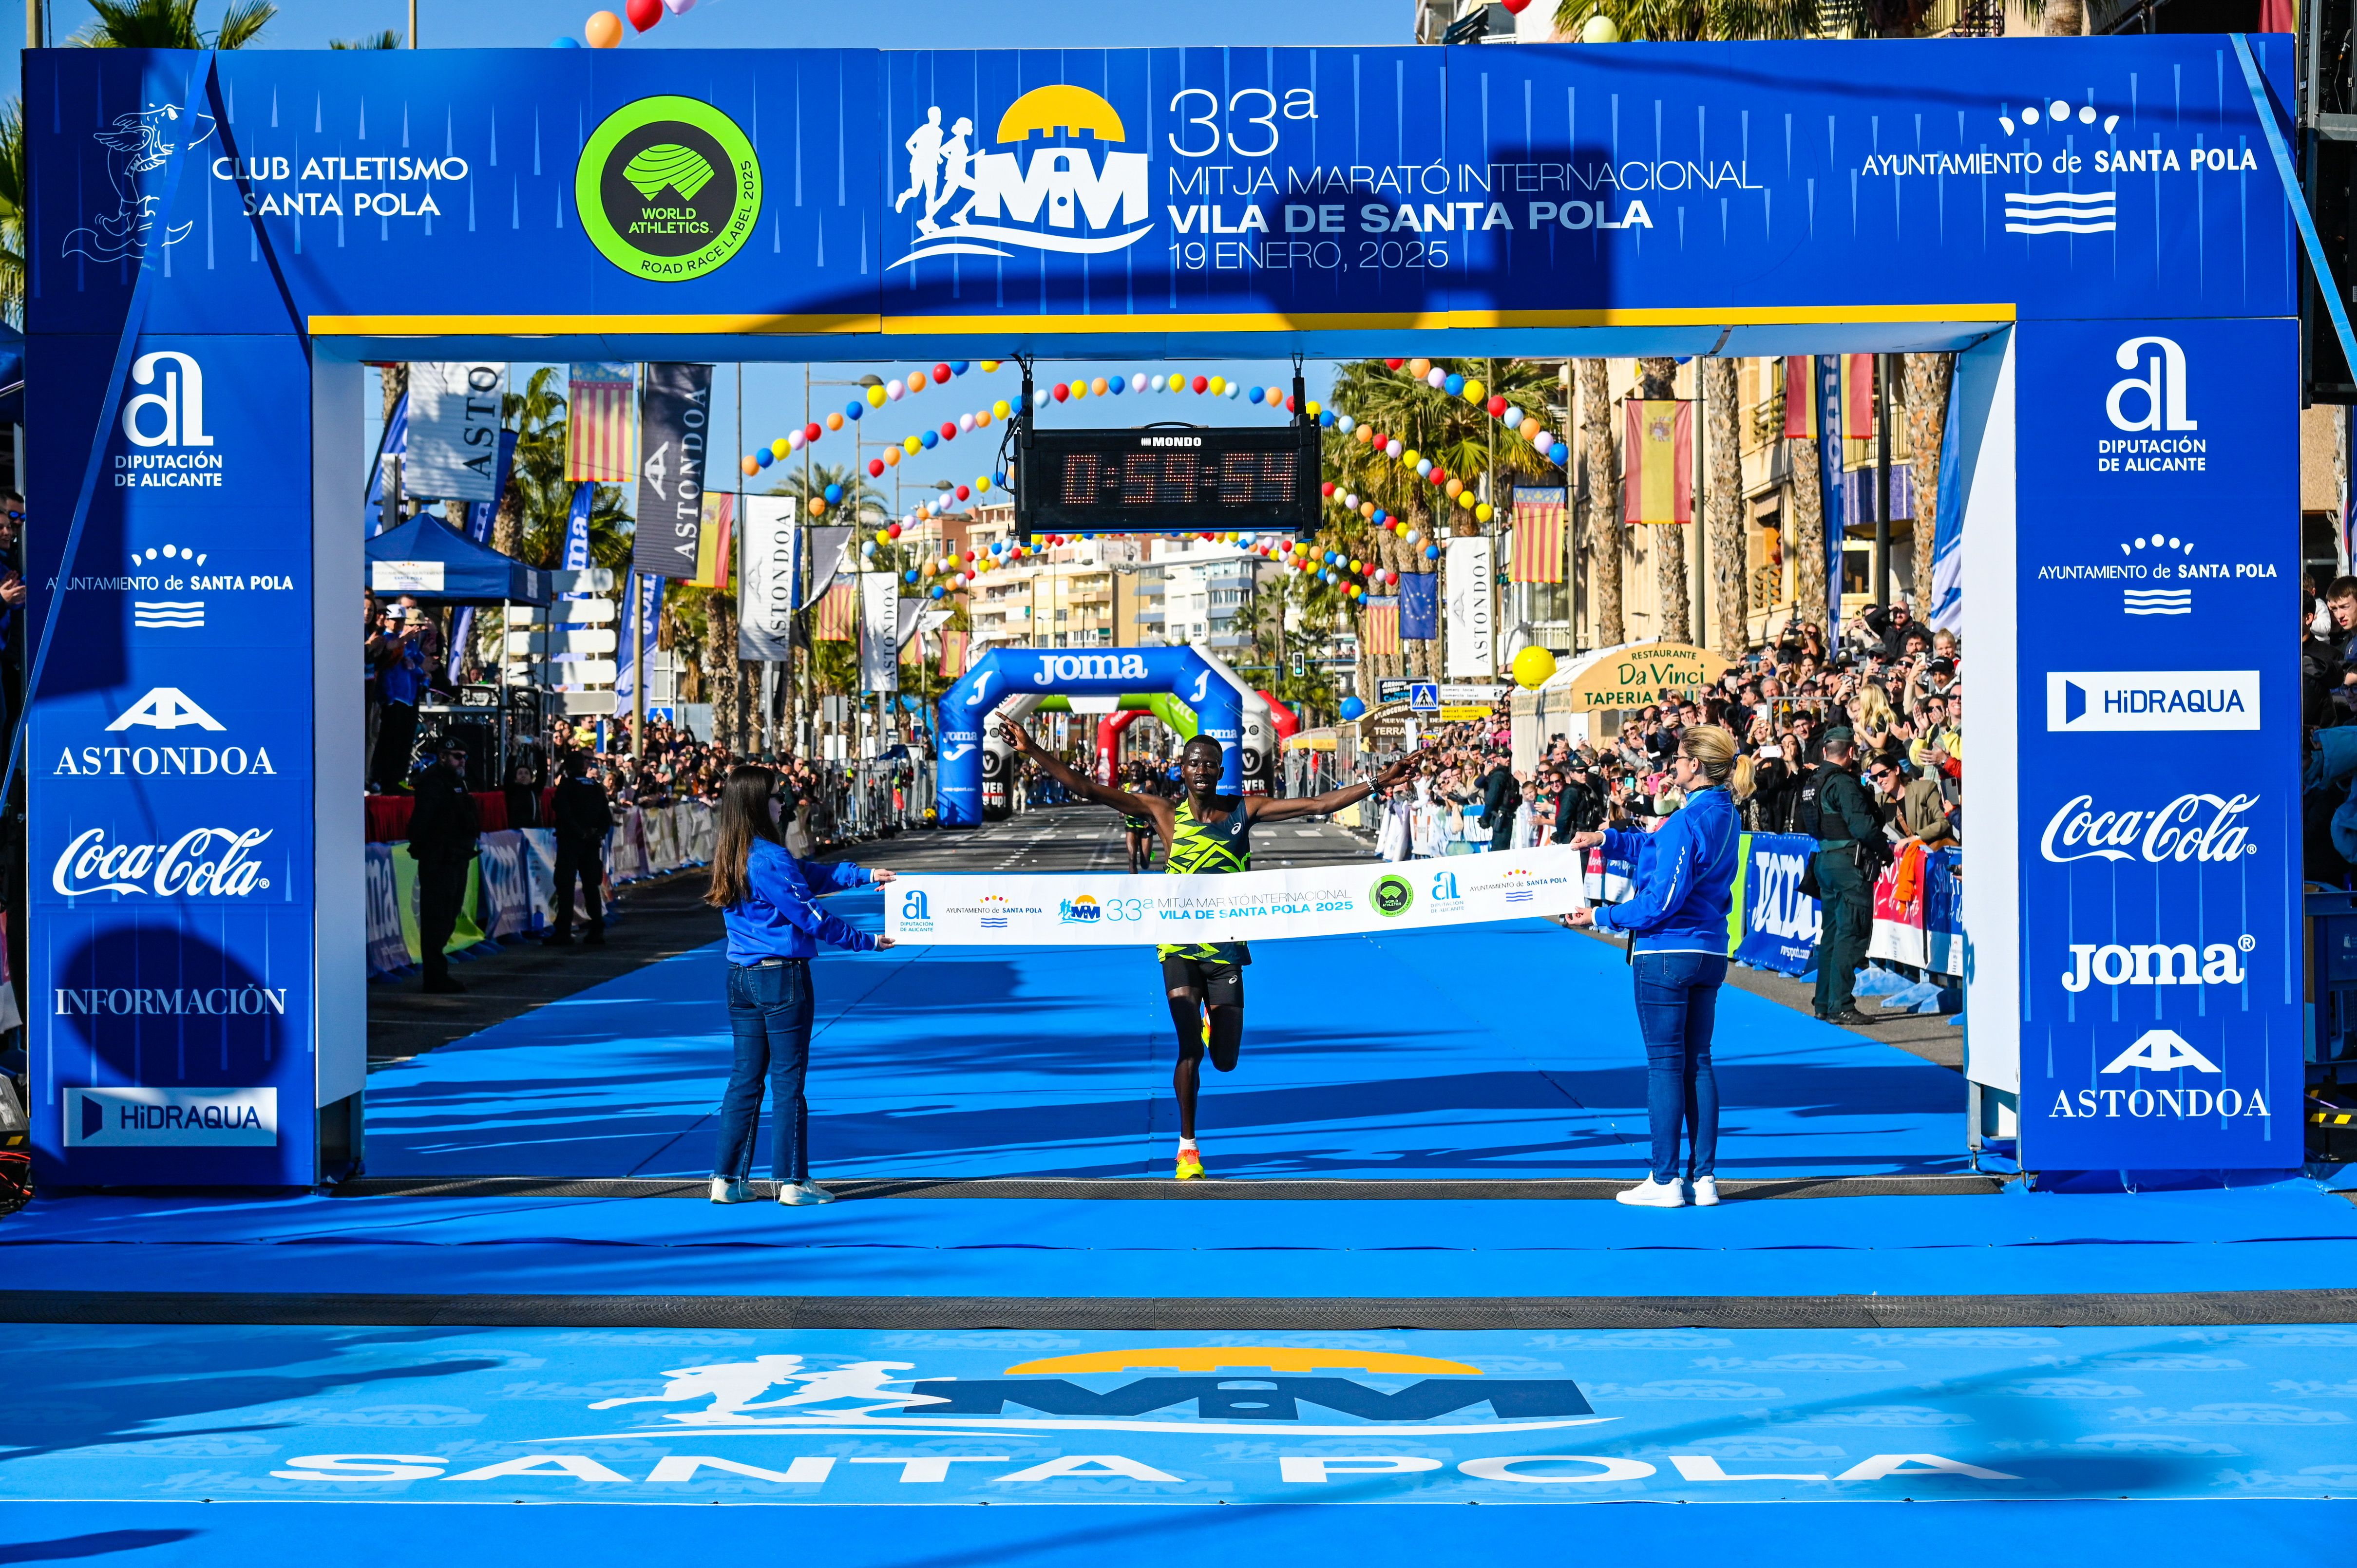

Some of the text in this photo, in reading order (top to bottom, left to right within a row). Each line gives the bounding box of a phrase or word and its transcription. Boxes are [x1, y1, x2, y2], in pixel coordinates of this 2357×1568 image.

[212, 157, 468, 181] CLUB ATLETISMO
[1862, 148, 2258, 176] AYUNTAMIENTO de SANTA POLA
[1169, 158, 1764, 195] MITJA MARATÓ INTERNACIONAL
[243, 192, 441, 216] SANTA POLA
[642, 208, 697, 220] WORLD
[640, 160, 753, 275] ROAD RACE LABEL 2025
[1167, 200, 1654, 234] VILA DE SANTA POLA
[1169, 240, 1449, 273] 19 ENERO, 2025
[1153, 436, 1201, 447] MONDO
[2099, 435, 2206, 454] DIPUTACIÓN
[115, 451, 222, 469] DIPUTACIÓN
[2098, 457, 2206, 472] DE ALICANTE
[115, 473, 222, 487] DE ALICANTE
[673, 387, 707, 562] ASTONDOA
[164, 575, 184, 590] de
[190, 576, 245, 590] SANTA
[250, 576, 294, 590] POLA
[770, 513, 791, 649] ASTONDOA
[2038, 564, 2277, 580] AYUNTAMIENTO de SANTA POLA
[1475, 551, 1488, 664] ASTONDOA
[884, 585, 895, 681] ASTONDOA
[1632, 649, 1697, 661] RESTAURANTE
[1617, 663, 1704, 685] Da Vinci
[1584, 691, 1654, 705] TAPERIA
[2104, 689, 2245, 714] HiDRAQUA
[53, 746, 277, 775] ASTONDOA
[1158, 897, 1195, 908] MITJA
[1251, 889, 1352, 905] INTERNACIONAL
[1469, 882, 1514, 892] AYUNTAMIENTO
[1159, 900, 1353, 920] VILA DE SANTA POLA 2025
[55, 983, 287, 1015] INFORMACIÓN
[2049, 1088, 2271, 1118] ASTONDOA
[121, 1105, 262, 1129] HiDRAQUA
[269, 1454, 2026, 1484] SANTA POLA
